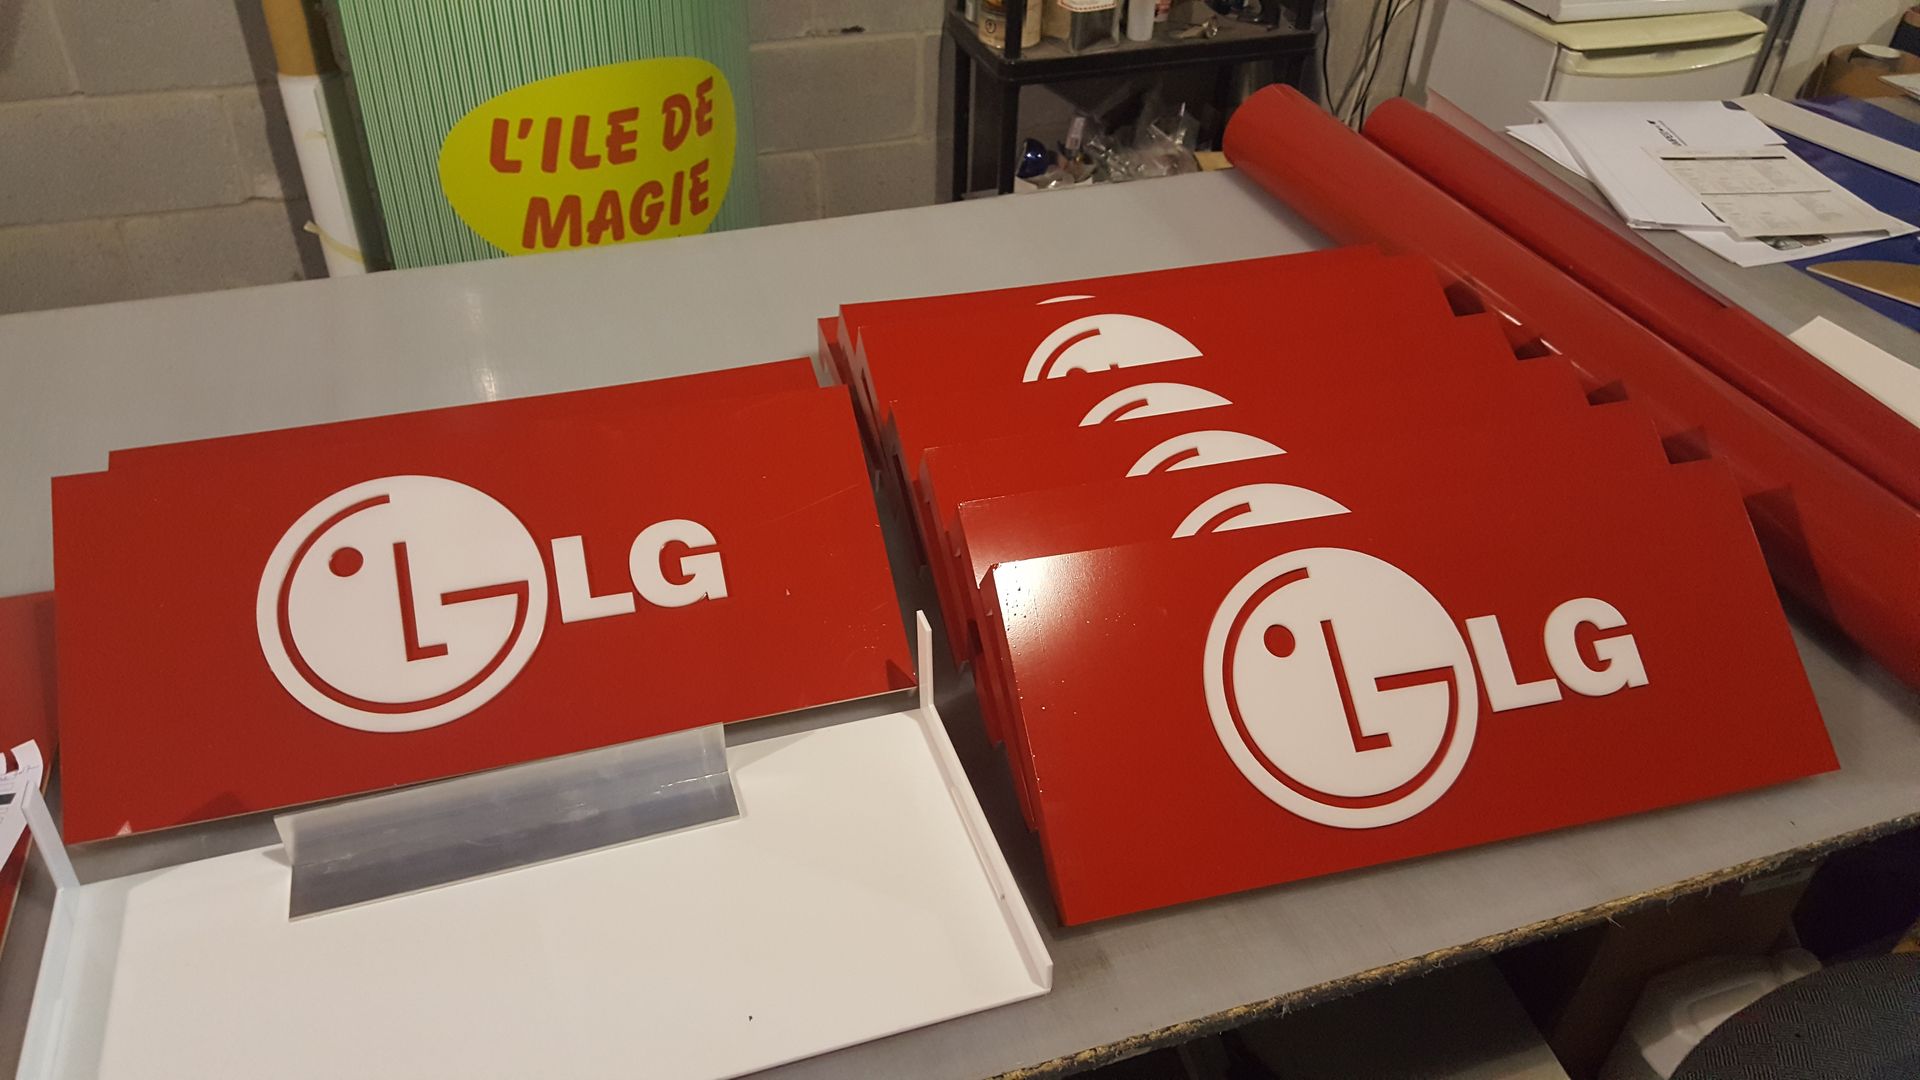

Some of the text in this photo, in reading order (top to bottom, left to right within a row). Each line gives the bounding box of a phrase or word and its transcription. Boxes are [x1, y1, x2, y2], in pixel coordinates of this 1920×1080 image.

[489, 76, 714, 174] L'ILE DE
[522, 158, 710, 250] MAGIE
[550, 518, 728, 625] LG
[1465, 597, 1650, 713] LG
